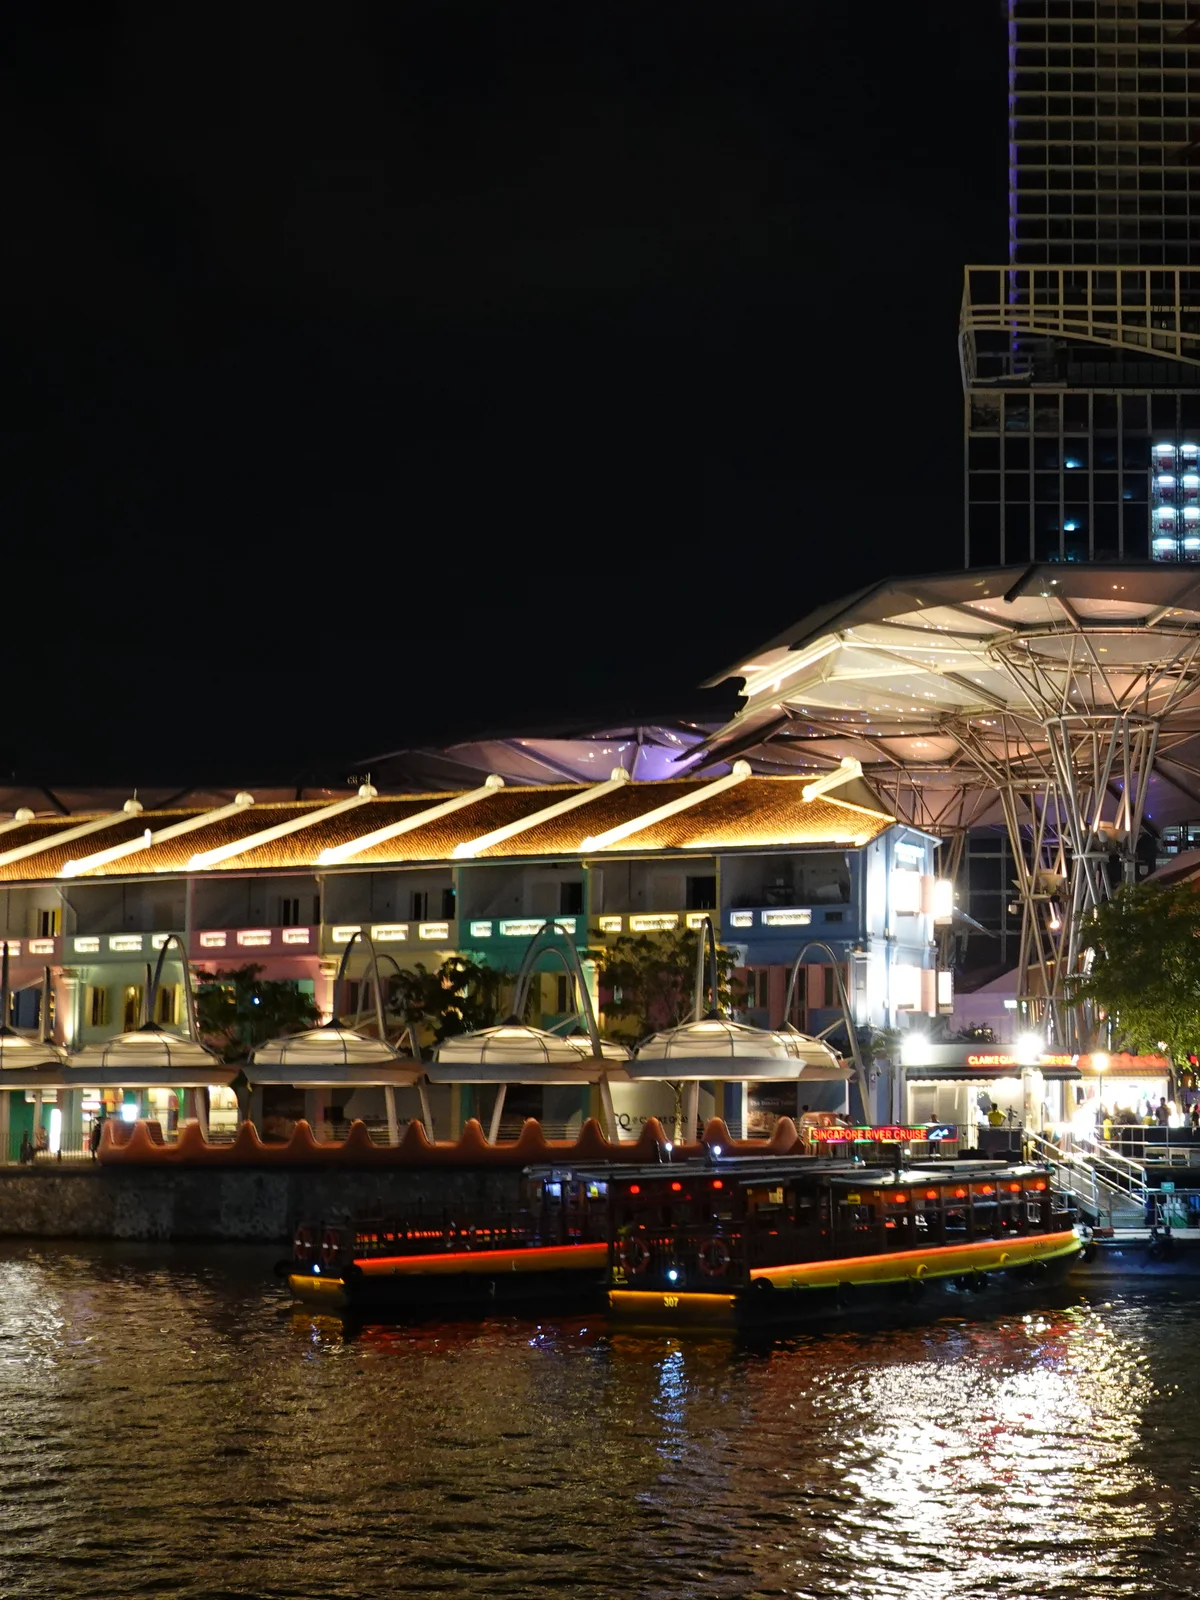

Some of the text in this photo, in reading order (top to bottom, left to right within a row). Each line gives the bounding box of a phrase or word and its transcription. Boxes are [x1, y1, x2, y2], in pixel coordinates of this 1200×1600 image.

[813, 1128, 927, 1140] SINGAPORE RIVER CRUISE
[663, 1296, 679, 1308] 307
